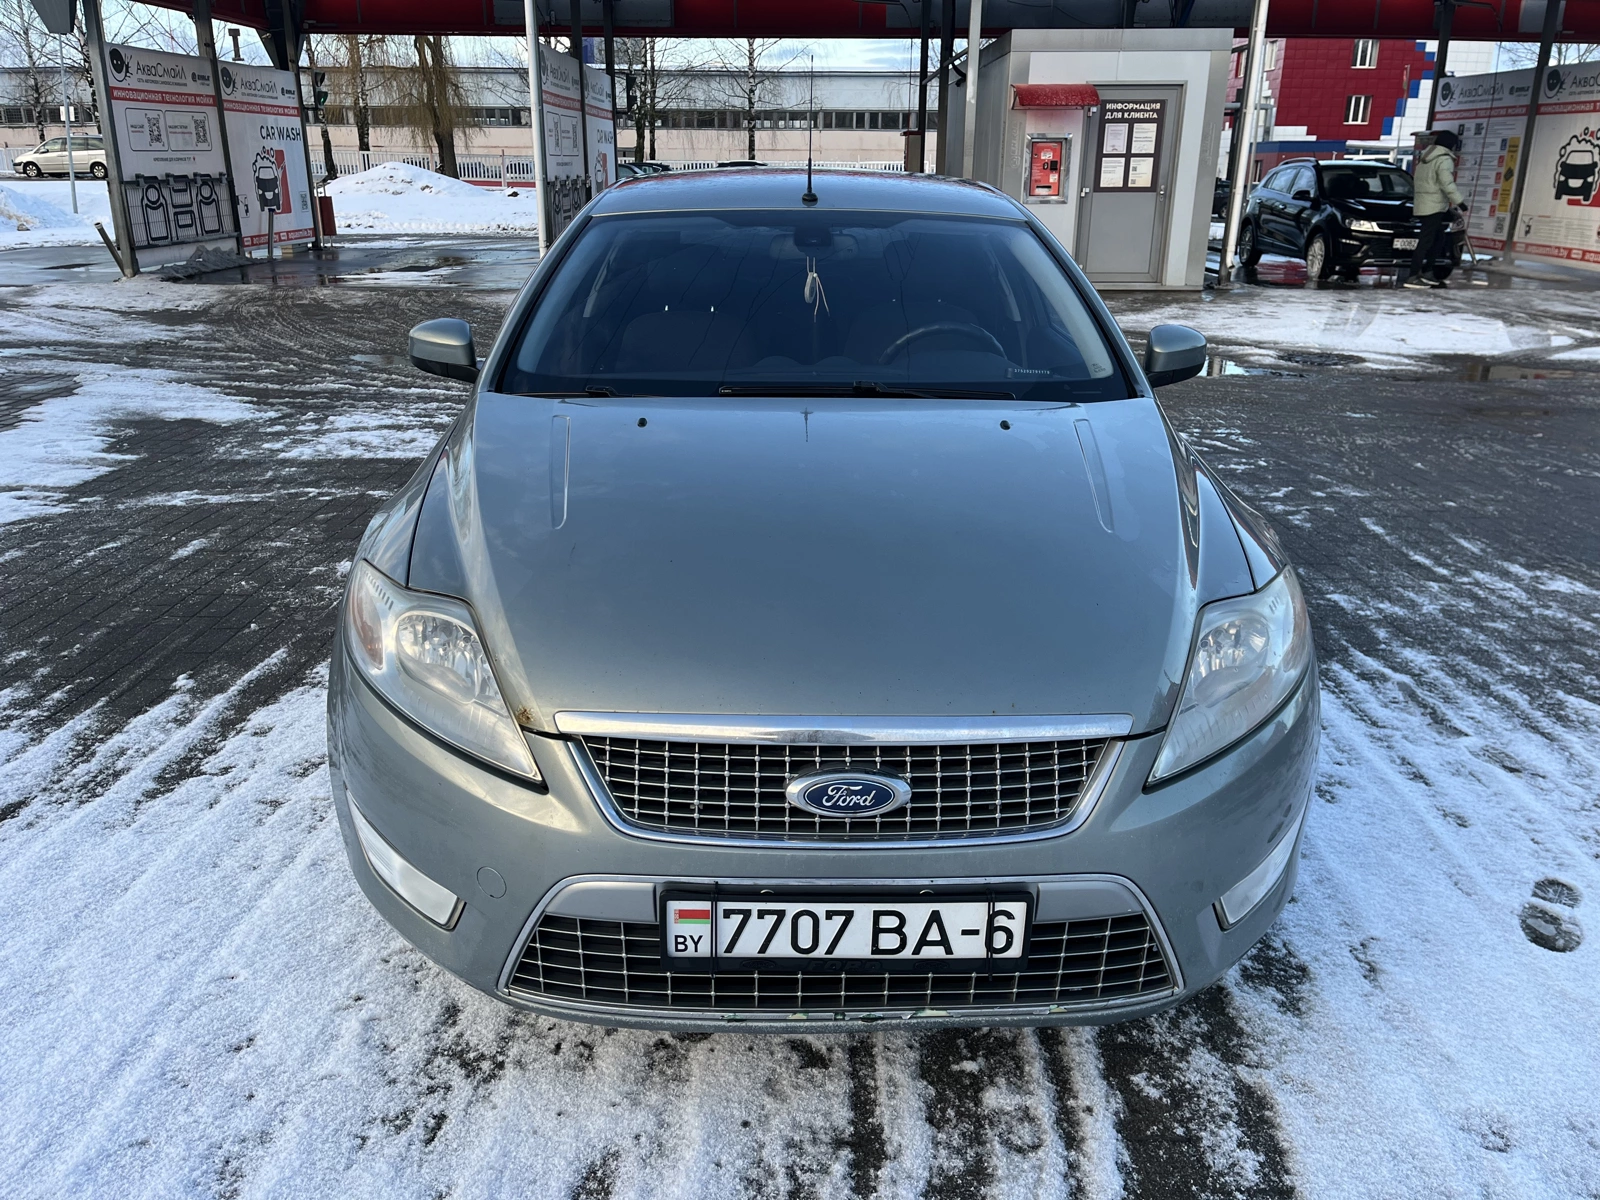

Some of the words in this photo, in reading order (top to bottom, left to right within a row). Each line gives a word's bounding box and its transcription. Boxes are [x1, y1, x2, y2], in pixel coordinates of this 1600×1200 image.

[1106, 102, 1161, 110] ИНФОРМАЦИЯ
[260, 125, 276, 140] CAR
[276, 126, 302, 141] WASH
[822, 784, 876, 806] Ford
[722, 908, 855, 955] 7707
[870, 909, 1016, 955] BA-6
[674, 934, 703, 953] BY
